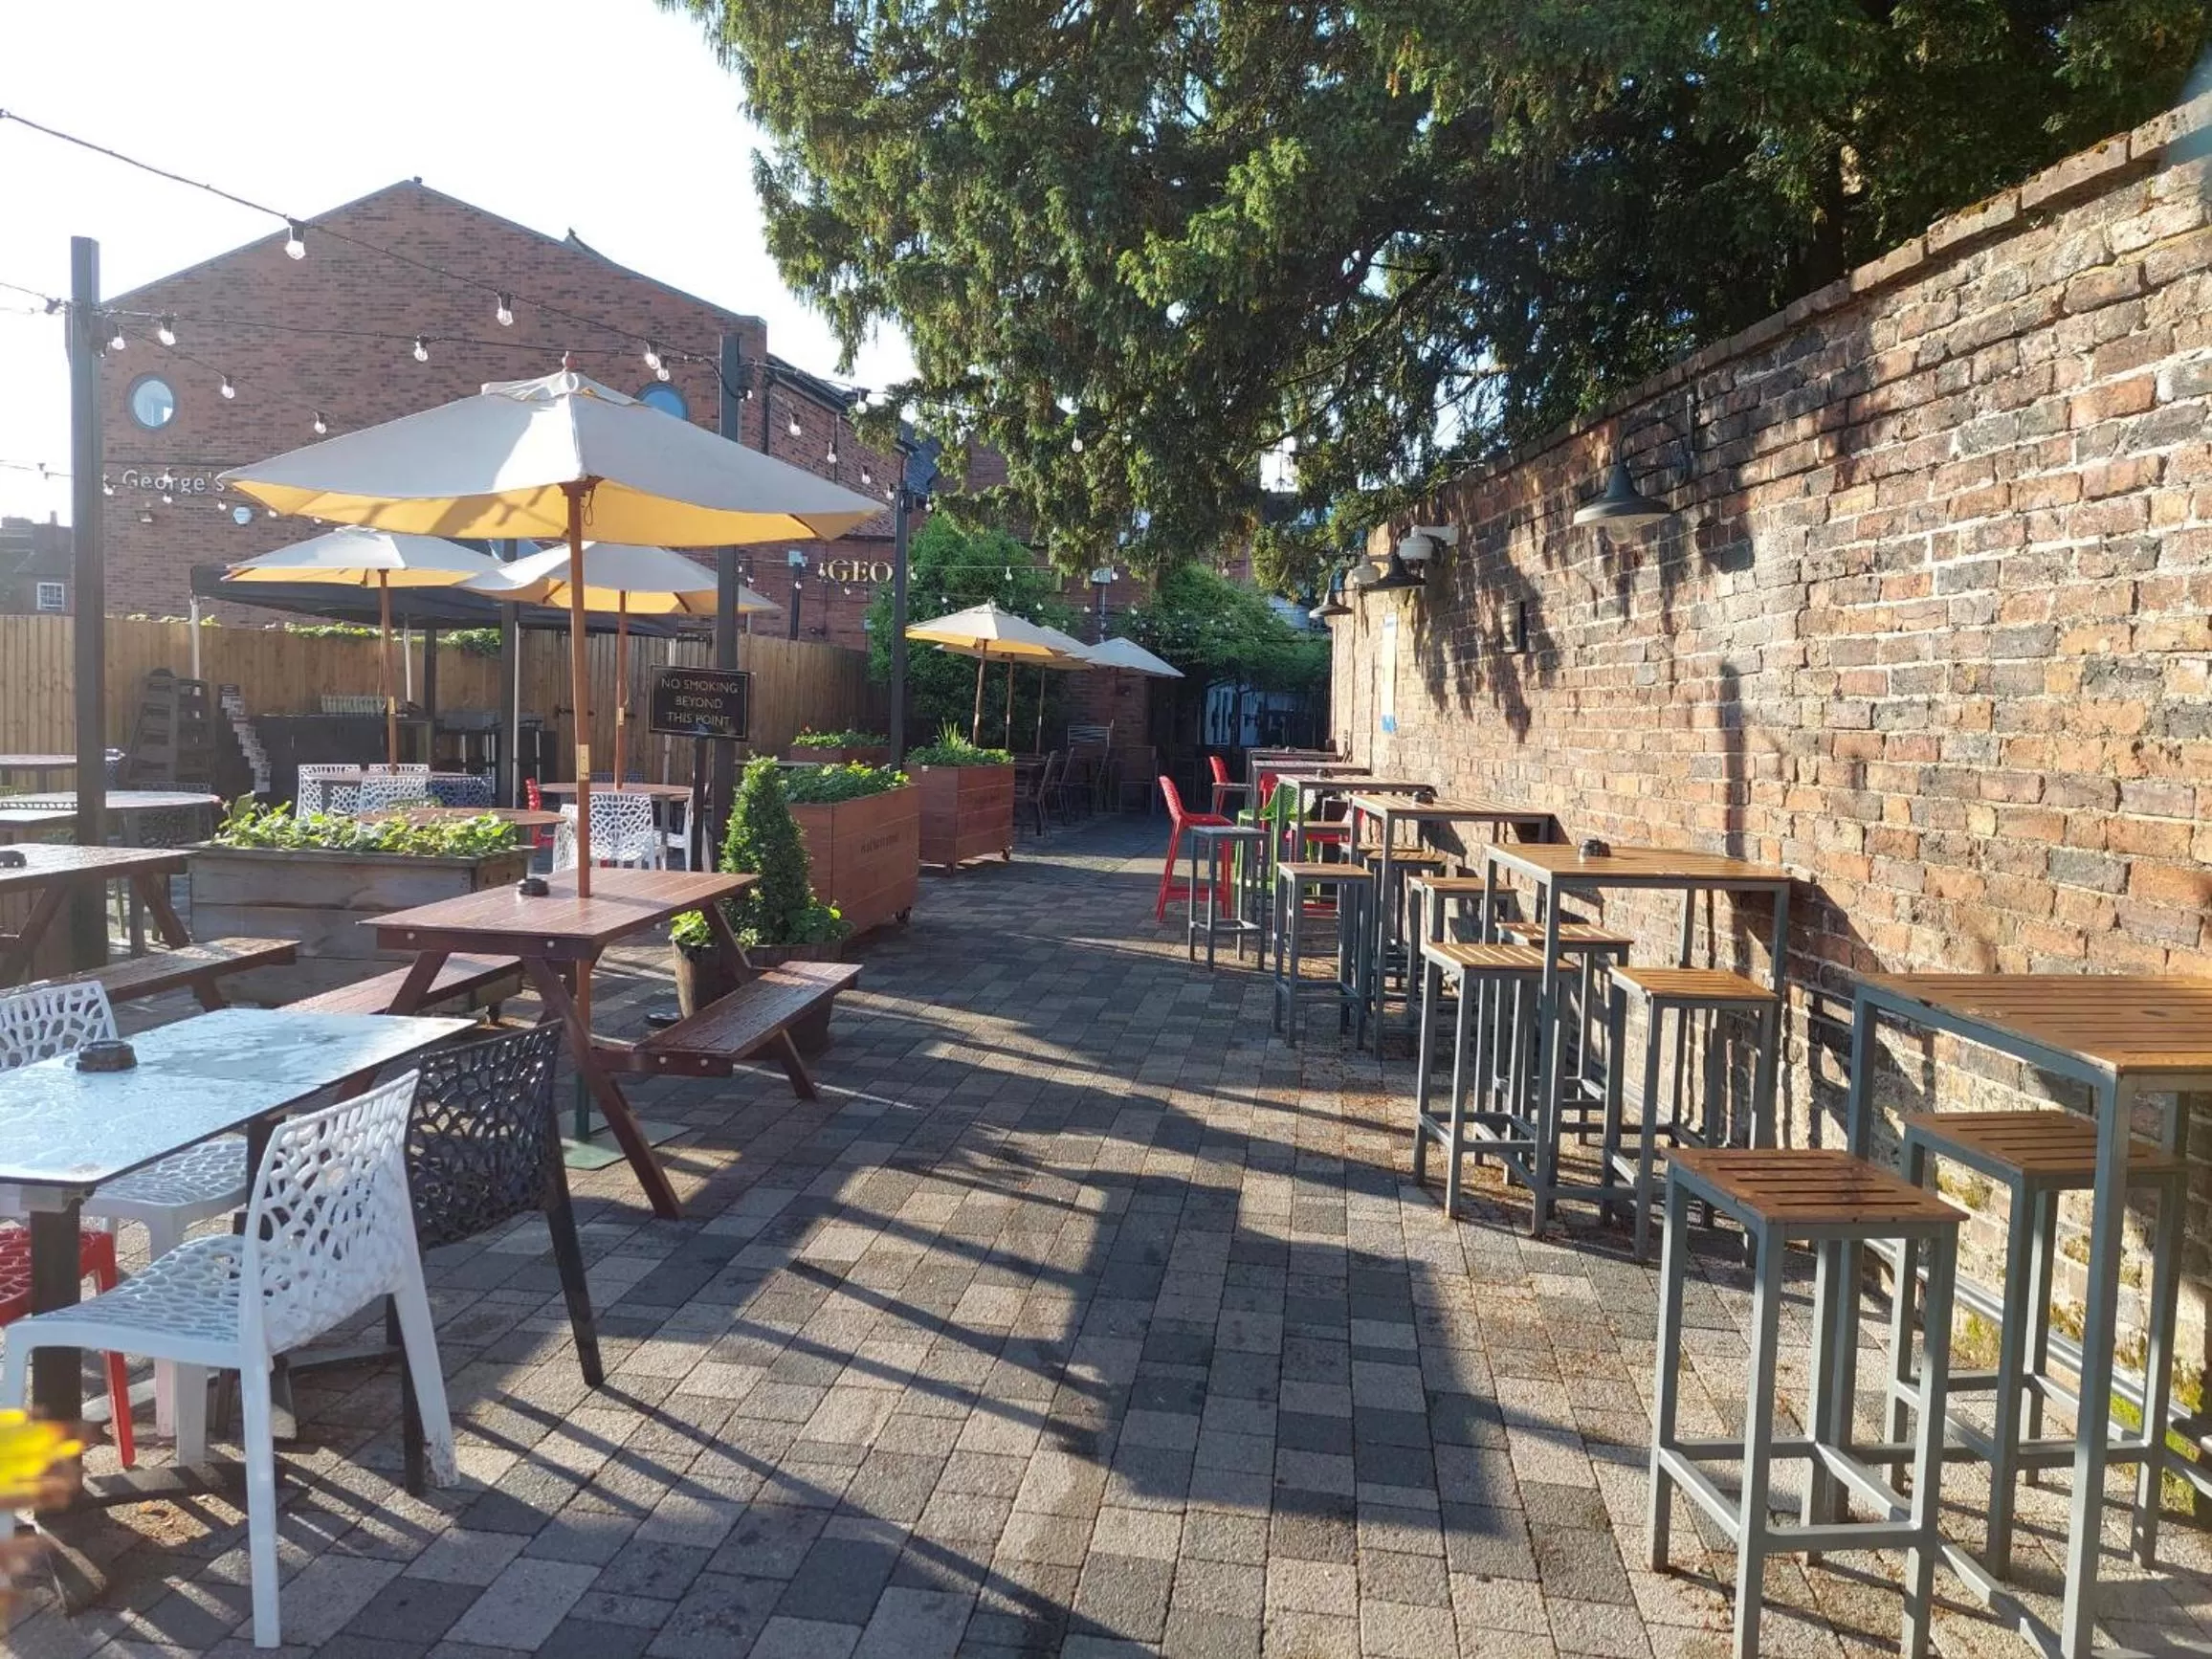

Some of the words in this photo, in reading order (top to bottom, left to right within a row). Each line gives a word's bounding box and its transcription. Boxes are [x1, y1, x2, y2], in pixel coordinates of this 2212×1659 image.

[122, 469, 225, 494] George's
[828, 559, 894, 583] GEO
[661, 677, 680, 689] NO
[683, 678, 739, 694] SMOKING
[675, 696, 723, 709] BEYOND
[666, 712, 693, 723] THIS
[696, 715, 733, 727] POINT
